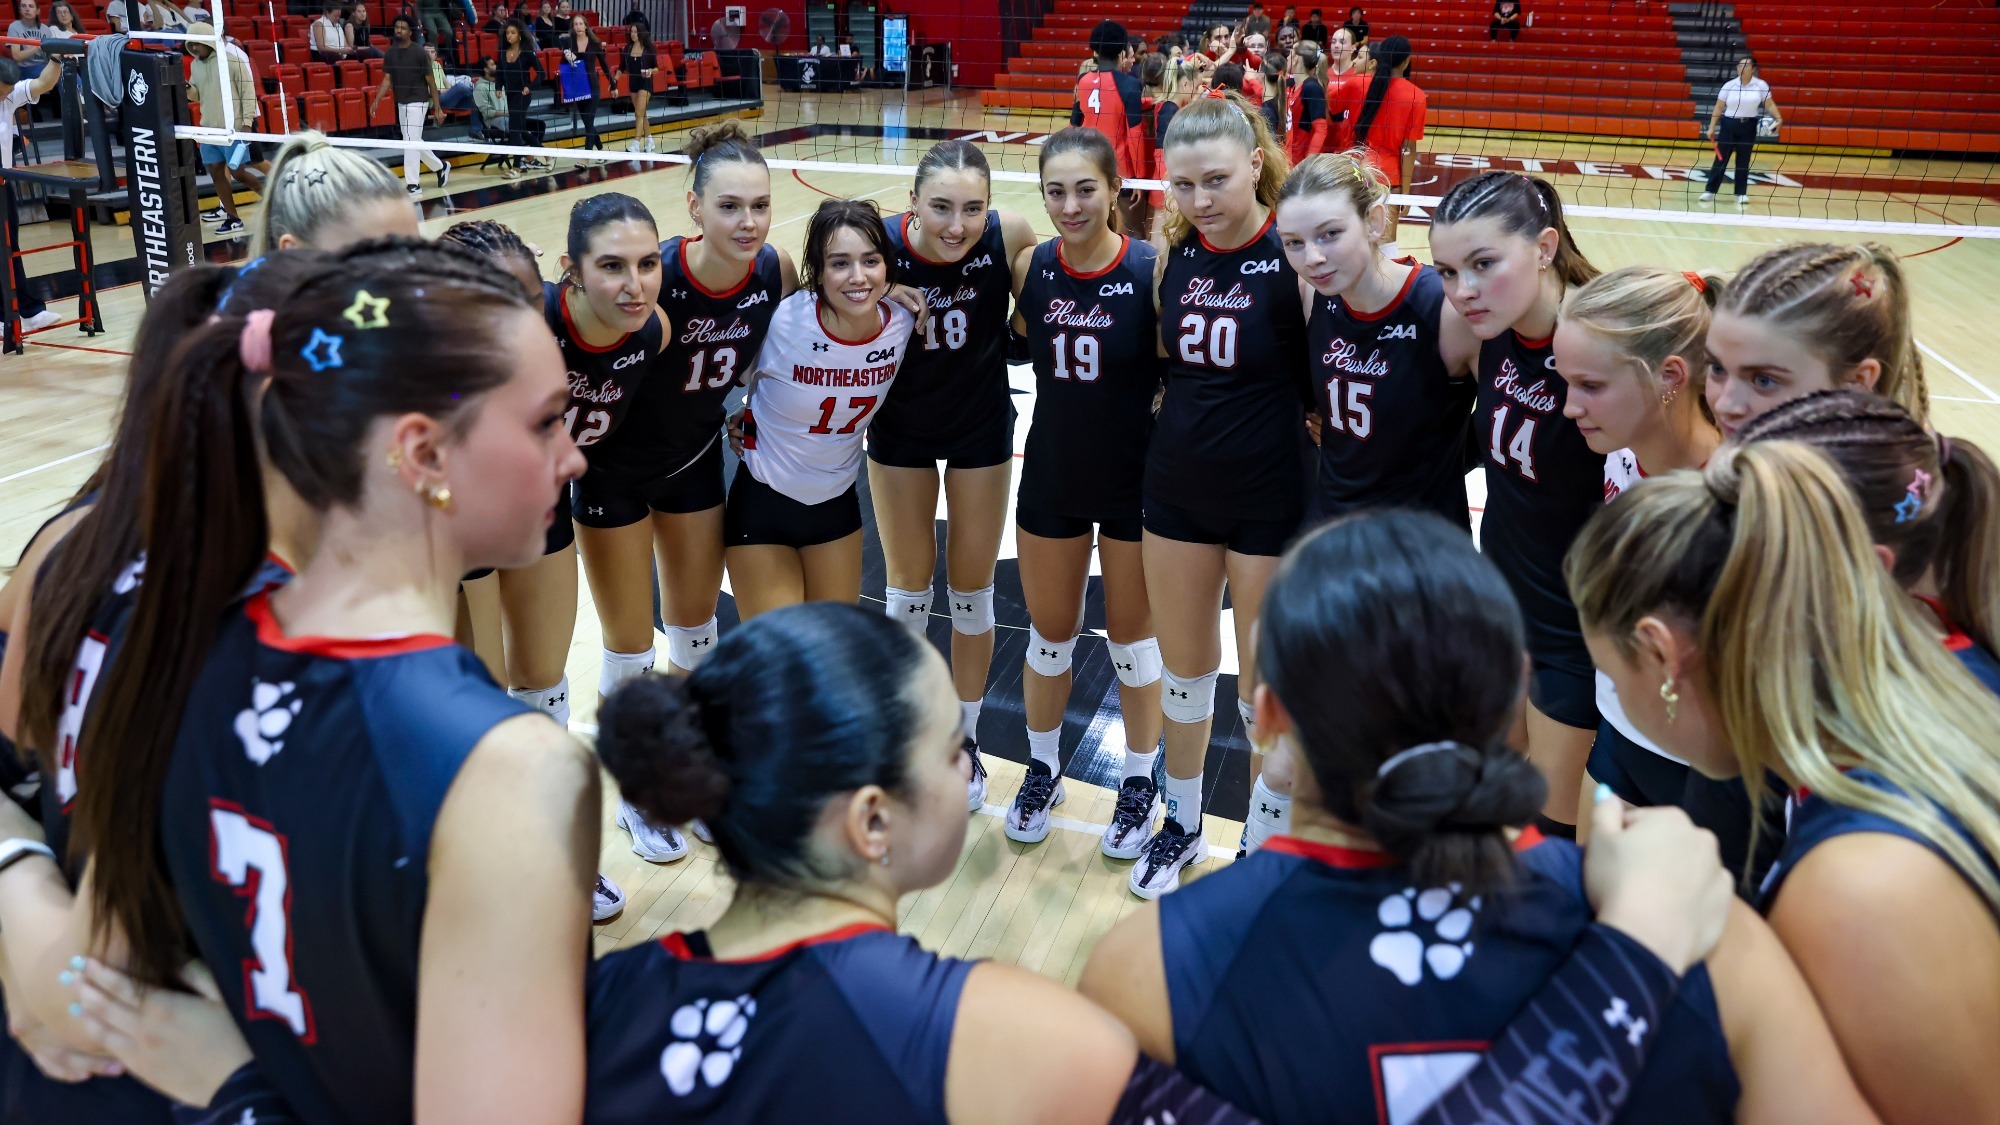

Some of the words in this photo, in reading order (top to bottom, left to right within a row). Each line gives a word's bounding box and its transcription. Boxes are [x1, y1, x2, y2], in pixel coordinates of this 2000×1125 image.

[1087, 88, 1101, 114] 4
[962, 253, 993, 276] CAA
[1239, 258, 1280, 275] CAA
[736, 289, 769, 309] CAA
[1098, 282, 1134, 297] CAA
[1180, 277, 1253, 309] Huskies
[1043, 298, 1114, 328] Huskies
[680, 317, 752, 344] Huskies
[923, 308, 968, 351] 18
[1178, 312, 1240, 369] 20
[1376, 324, 1417, 341] CAA
[612, 349, 645, 370] CAA
[683, 345, 738, 392] 13
[865, 346, 896, 364] CAA
[1051, 331, 1101, 382] 19
[792, 360, 898, 387] NORTHEASTERN
[1494, 357, 1557, 412] Huskies
[808, 394, 878, 435] 17
[1326, 376, 1373, 439] 15
[562, 404, 612, 448] 12
[1490, 403, 1538, 482] 14
[210, 800, 314, 1042] 7
